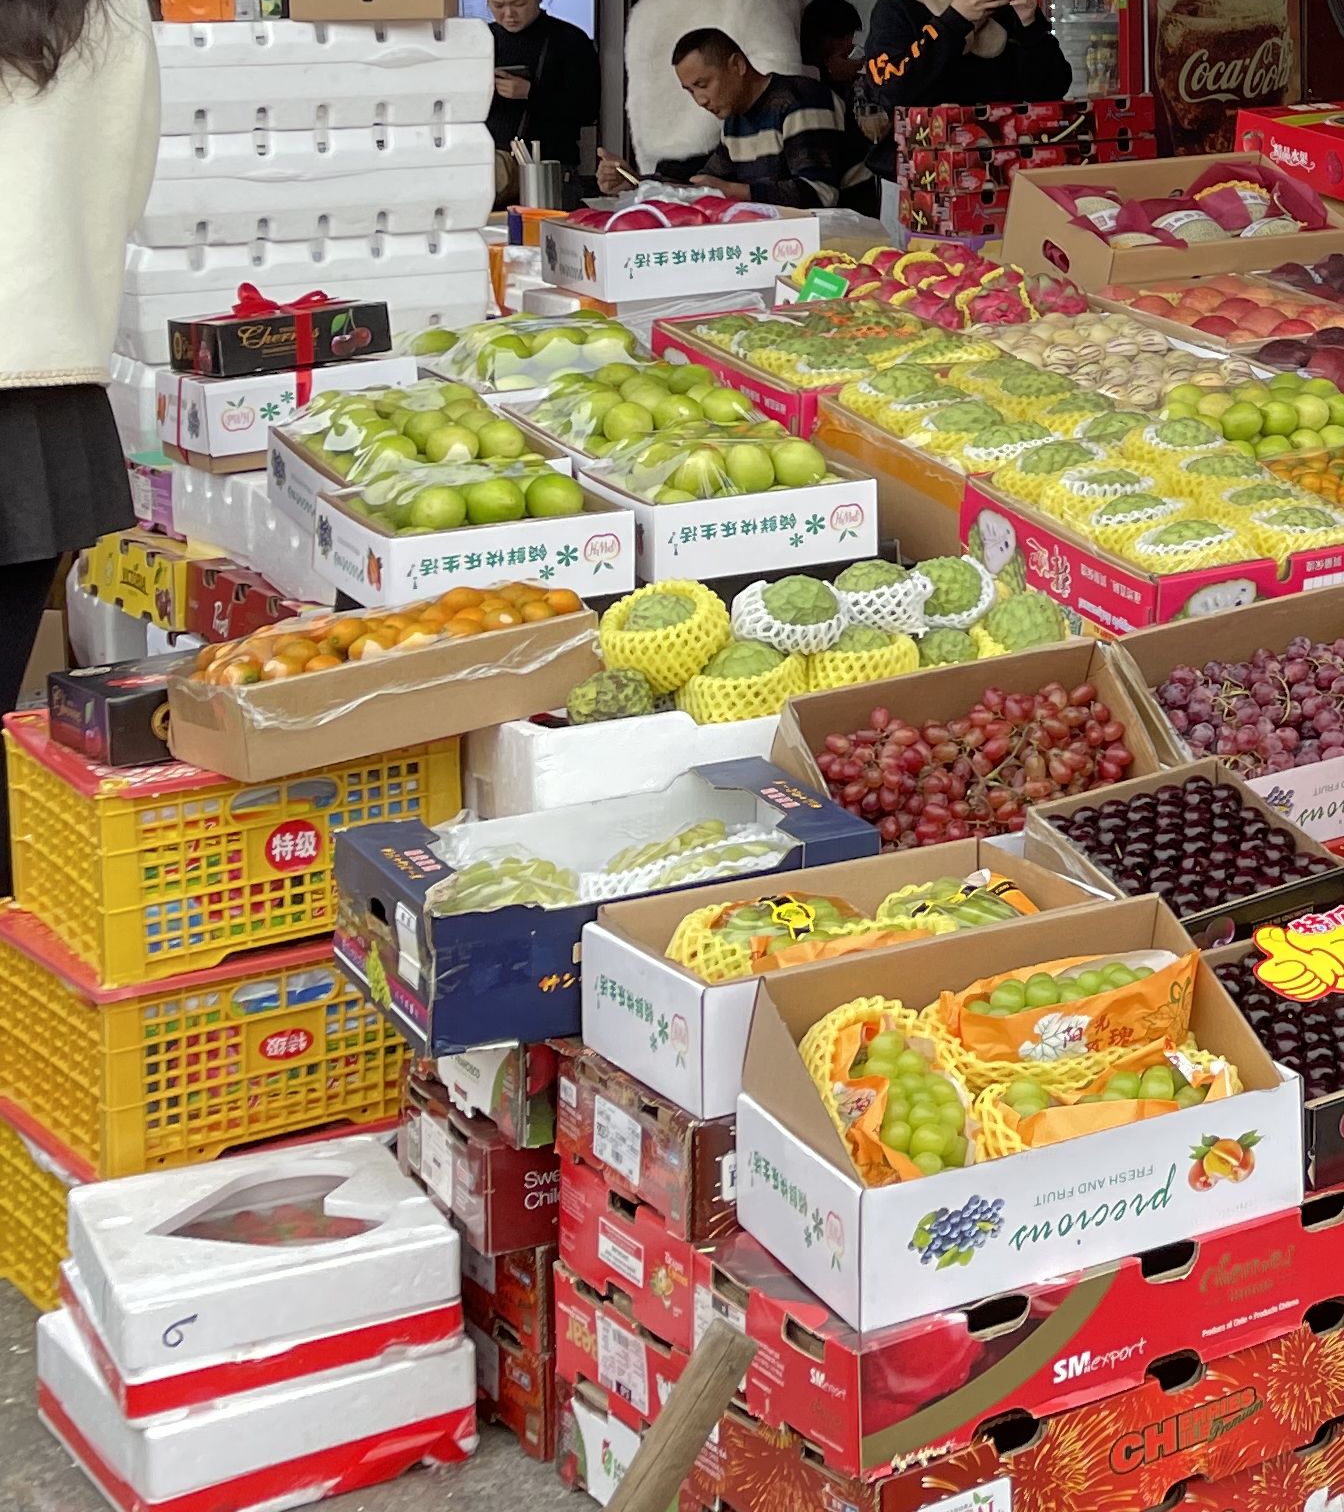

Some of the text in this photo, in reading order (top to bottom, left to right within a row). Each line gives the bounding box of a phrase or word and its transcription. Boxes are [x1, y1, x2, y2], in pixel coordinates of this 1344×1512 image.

[678, 514, 798, 545] 领鲜快乐生活
[418, 544, 549, 576] 领鲜快乐生活
[271, 828, 319, 864] 特级
[1033, 1164, 1155, 1208] FRESH AND FRUIT
